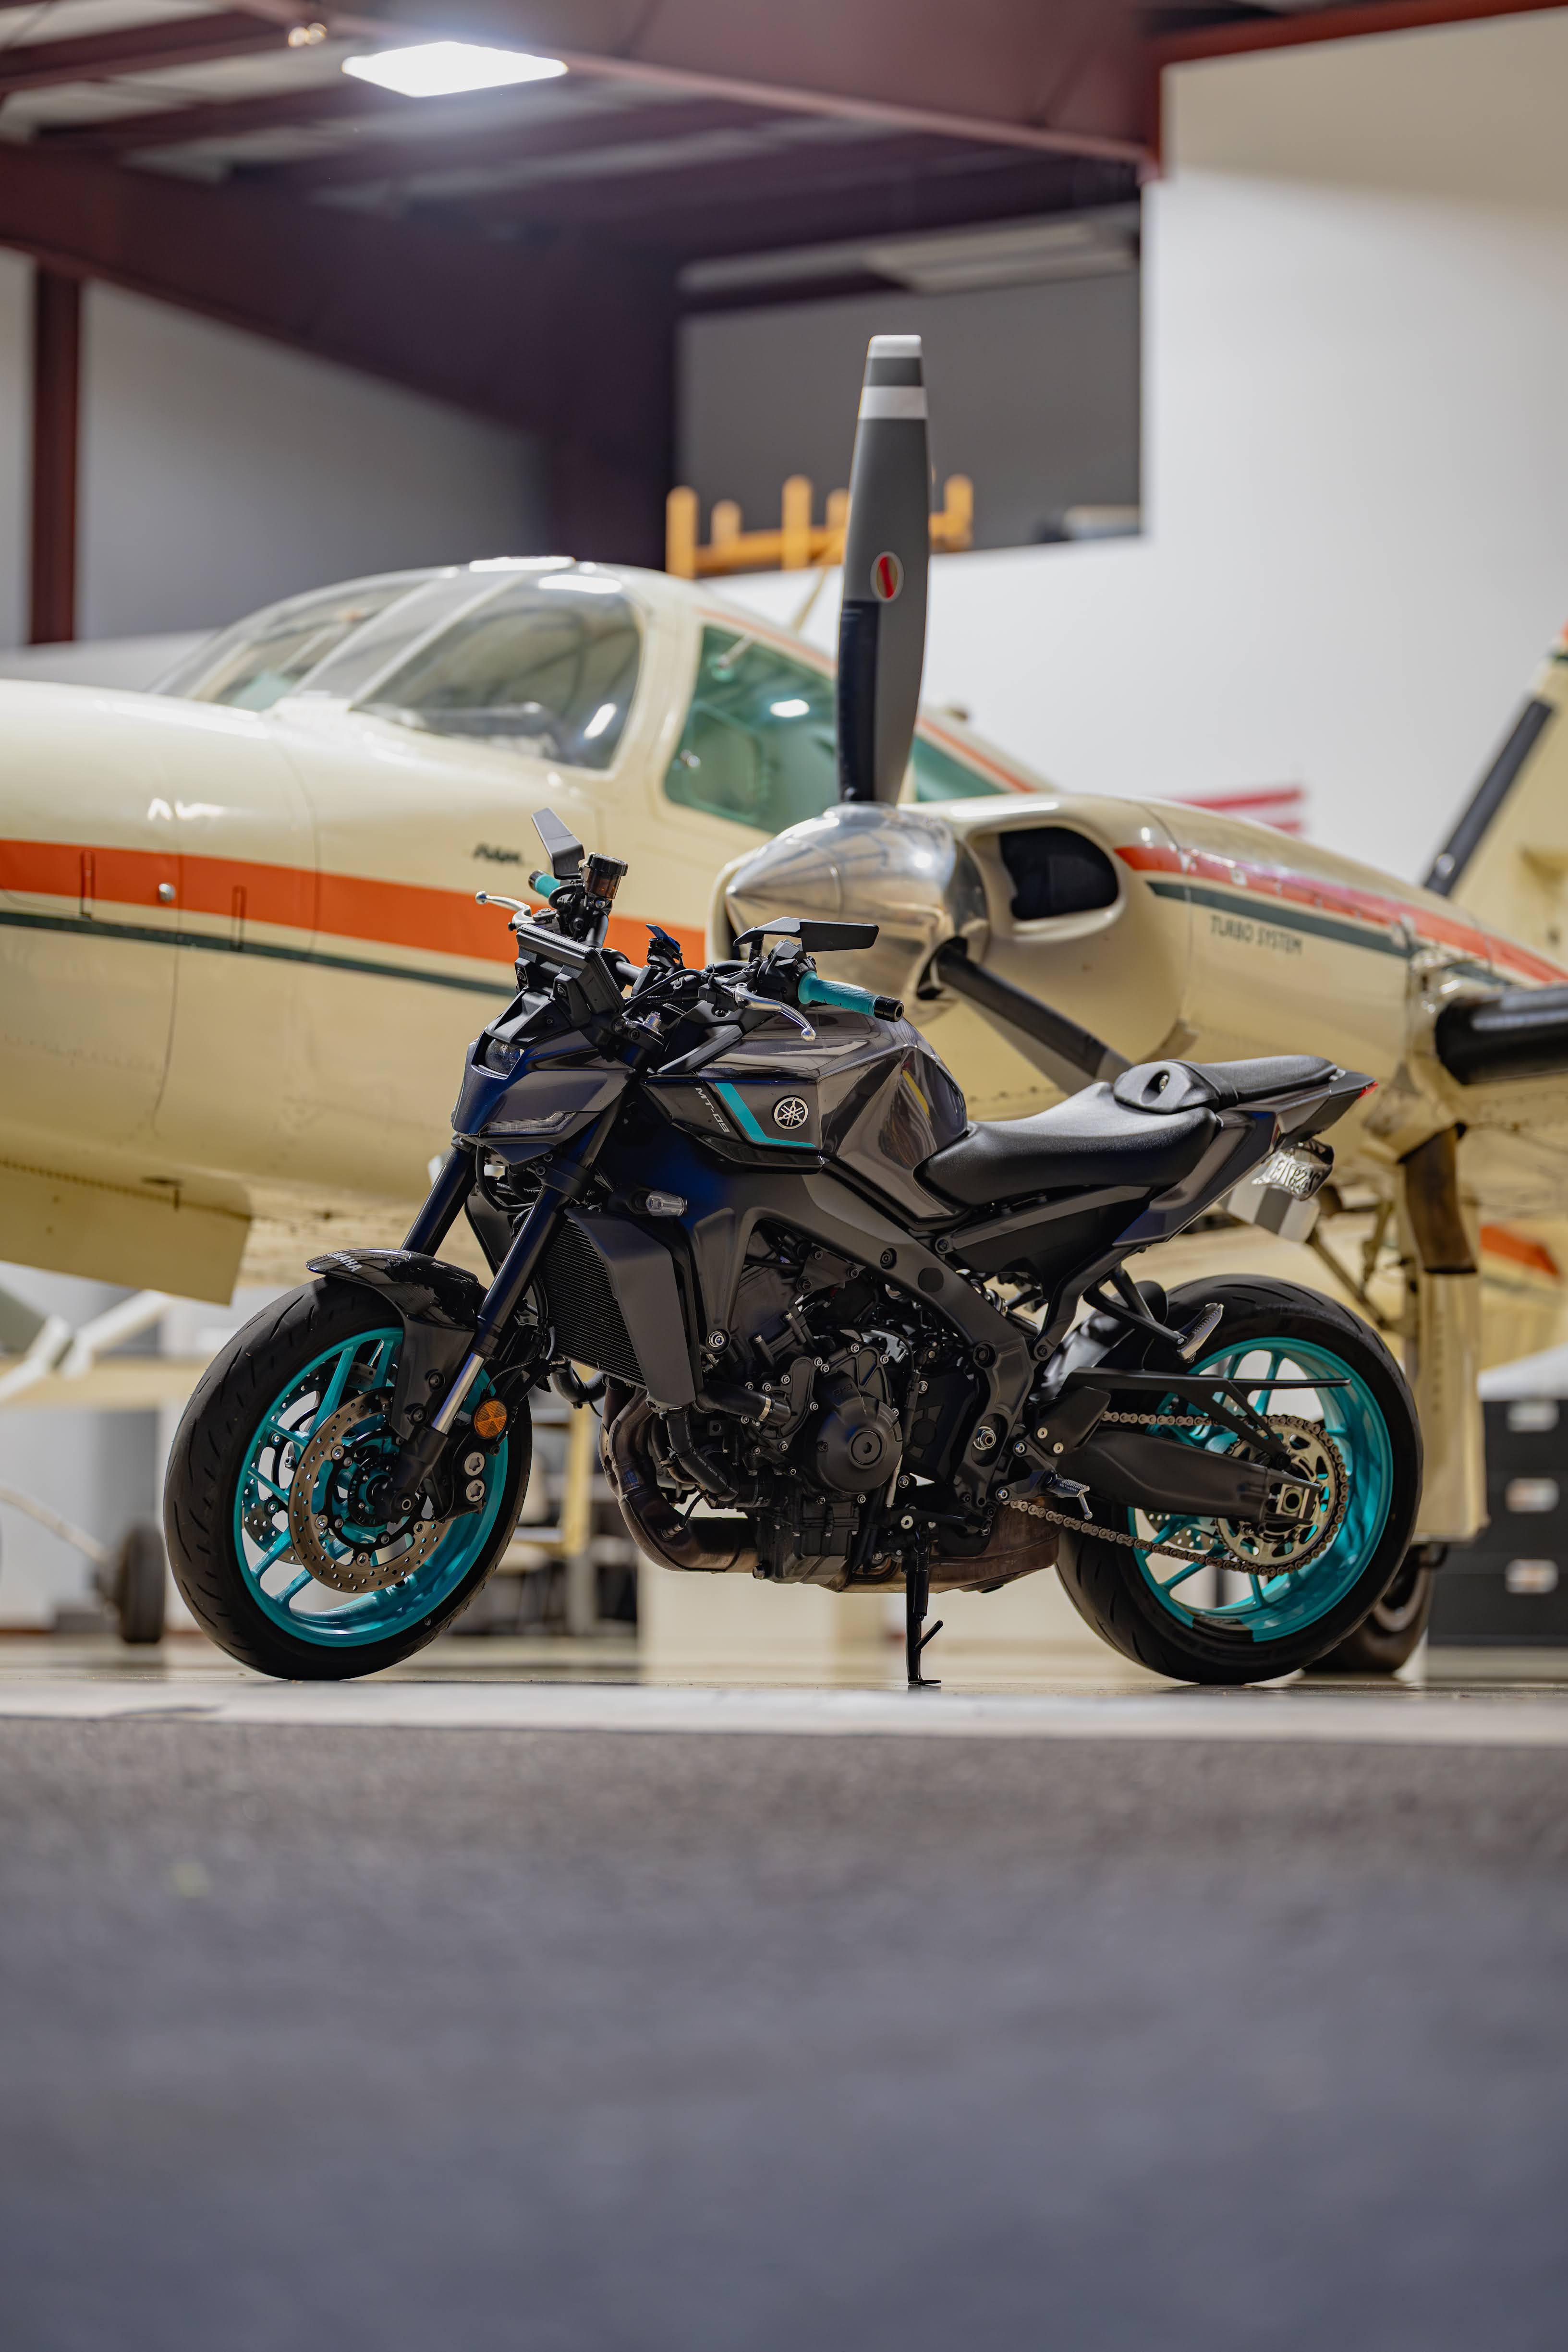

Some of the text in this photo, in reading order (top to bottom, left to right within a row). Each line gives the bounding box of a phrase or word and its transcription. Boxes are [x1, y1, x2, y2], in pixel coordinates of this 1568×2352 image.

[1210, 915, 1302, 955] TURBO SYSTEM
[695, 1087, 730, 1132] MT-09
[328, 1252, 363, 1272] MAHA
